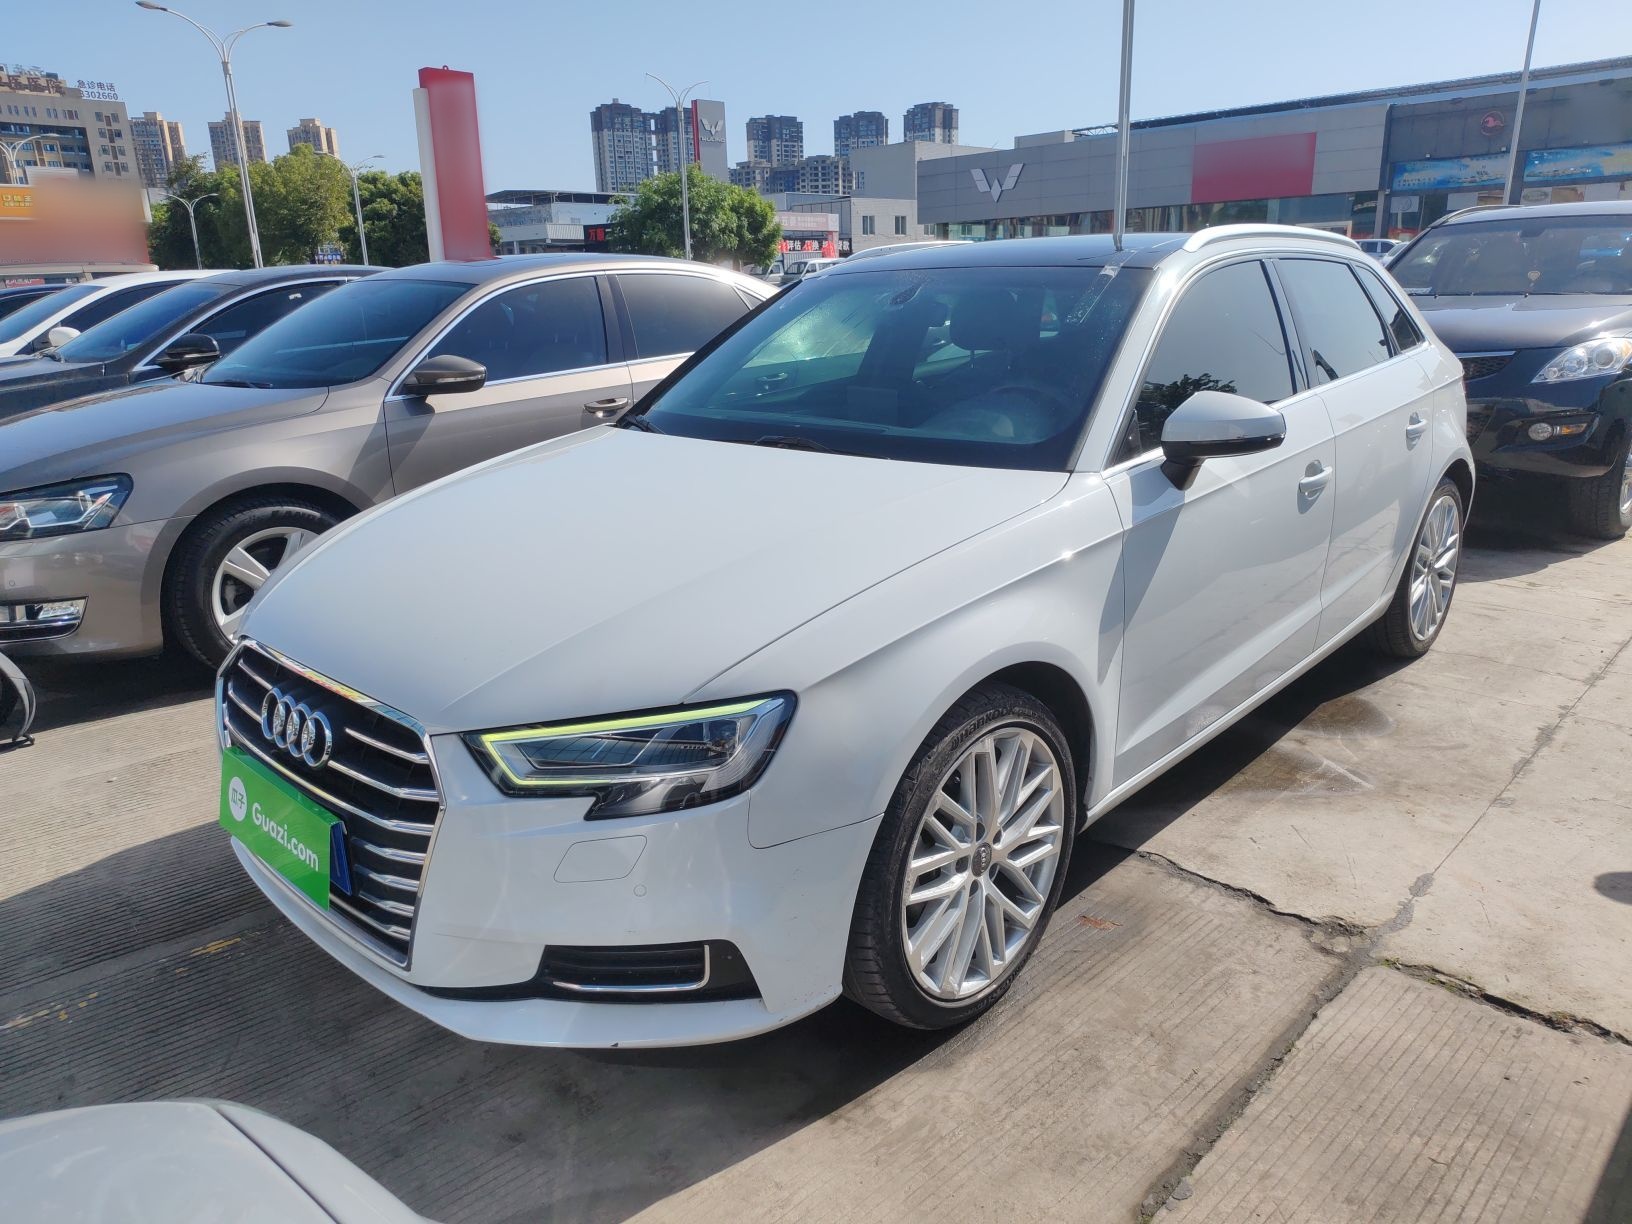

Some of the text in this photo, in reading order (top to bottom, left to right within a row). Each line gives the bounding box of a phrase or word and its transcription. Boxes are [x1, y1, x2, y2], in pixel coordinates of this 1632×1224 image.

[77, 79, 116, 92] 急诊电话
[252, 802, 320, 872] Guazi.com
